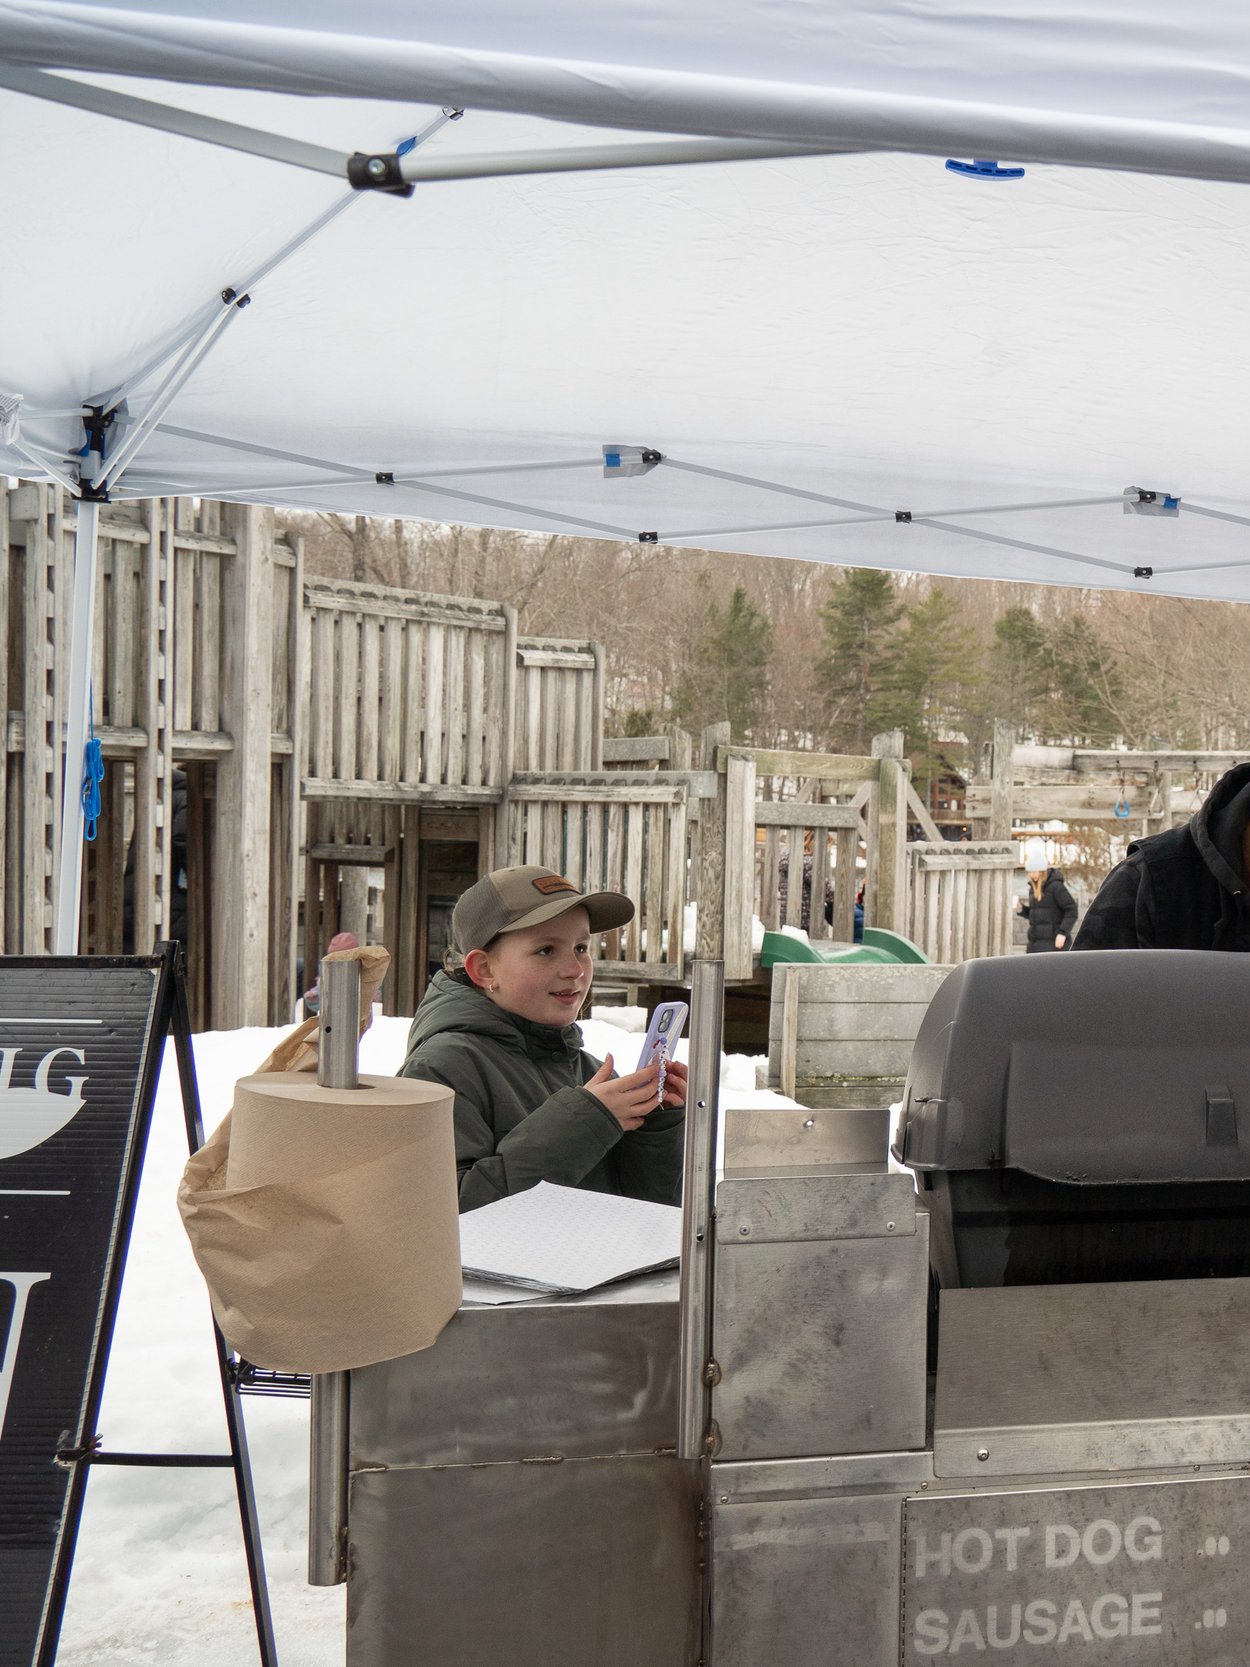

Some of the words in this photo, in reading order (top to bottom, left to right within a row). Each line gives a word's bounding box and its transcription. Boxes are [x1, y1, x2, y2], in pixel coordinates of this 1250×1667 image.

[912, 1527, 1030, 1578] HOT
[1045, 1516, 1162, 1568] DOG
[913, 1592, 1162, 1655] SAUSAGE
